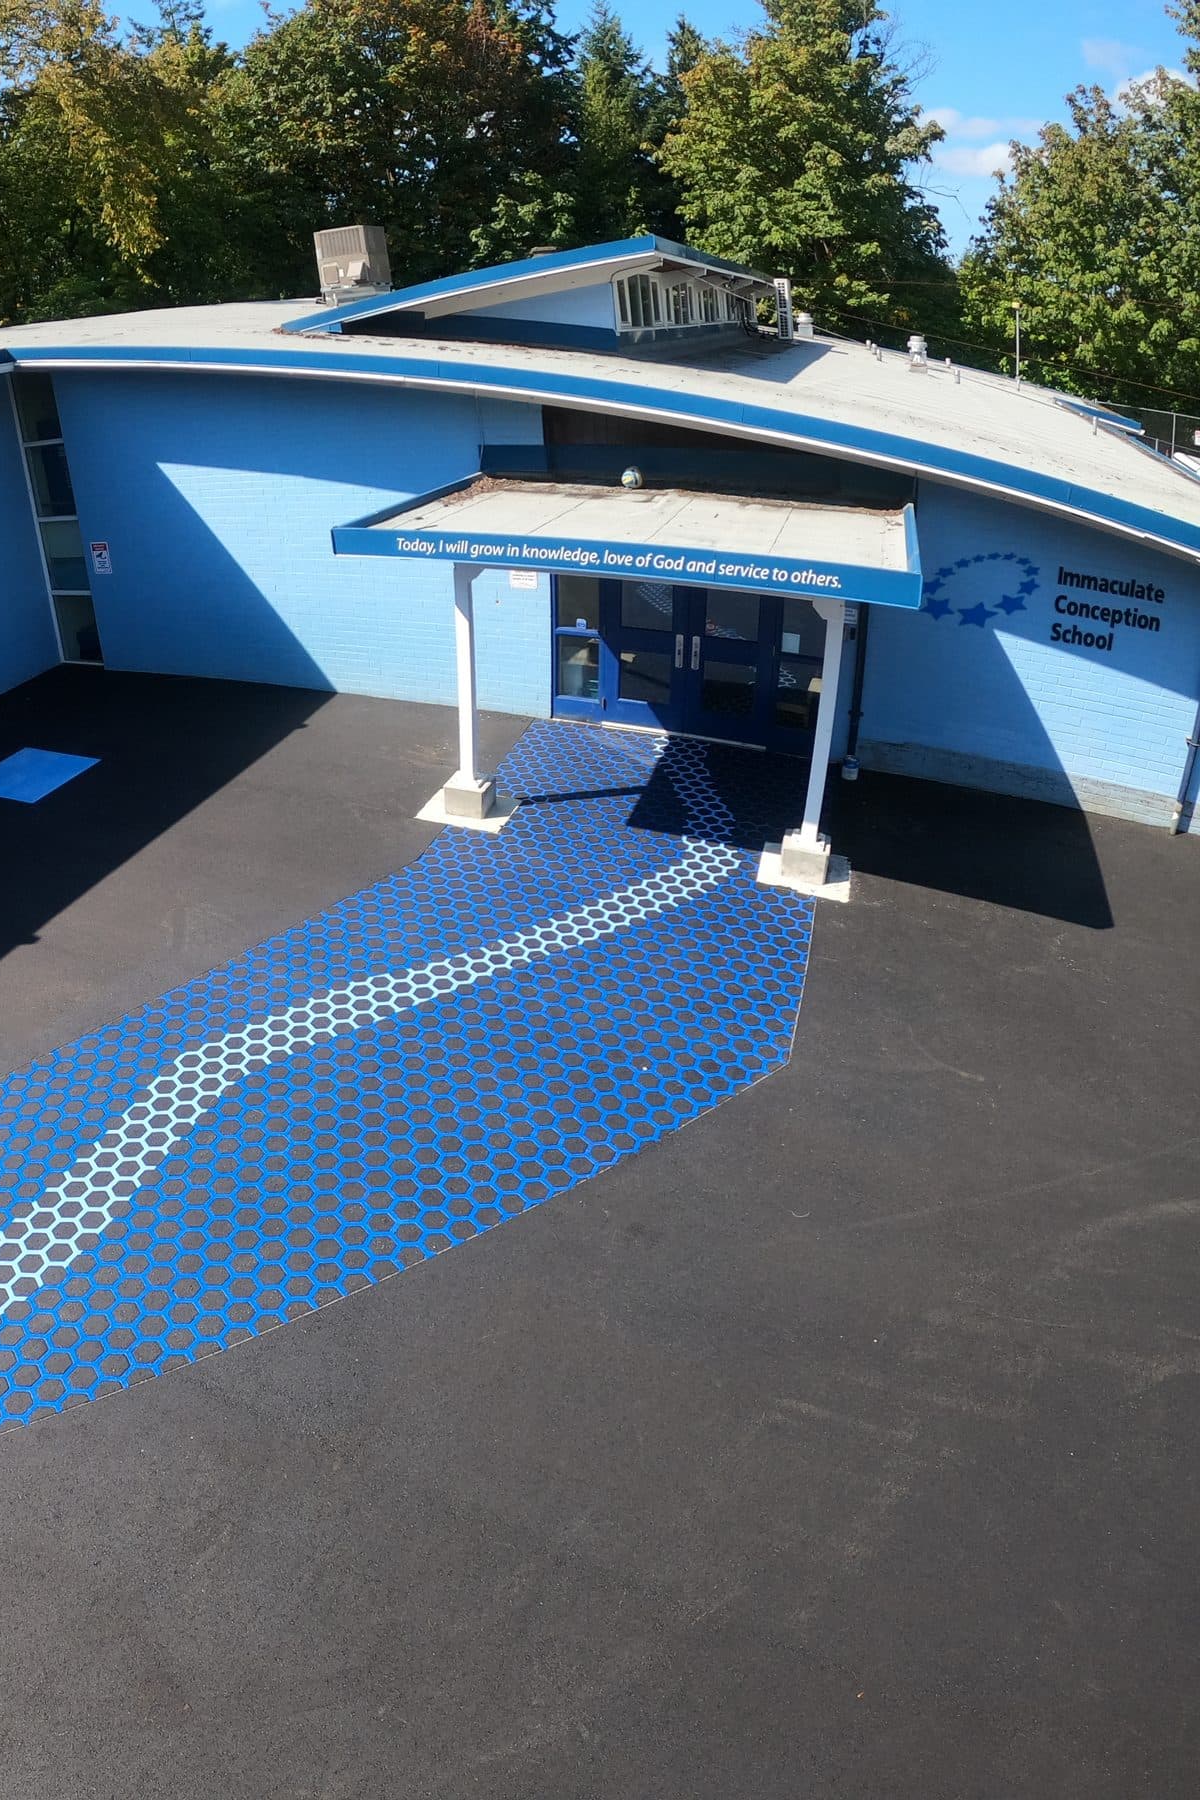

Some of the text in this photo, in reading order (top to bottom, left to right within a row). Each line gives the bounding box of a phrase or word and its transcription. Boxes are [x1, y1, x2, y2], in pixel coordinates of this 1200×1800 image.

[396, 537, 842, 588] Today, I will grow in knowledge, love of God and service to others.
[1057, 566, 1165, 604] Immaculate
[1054, 594, 1161, 632] Conception
[1050, 622, 1114, 651] School
